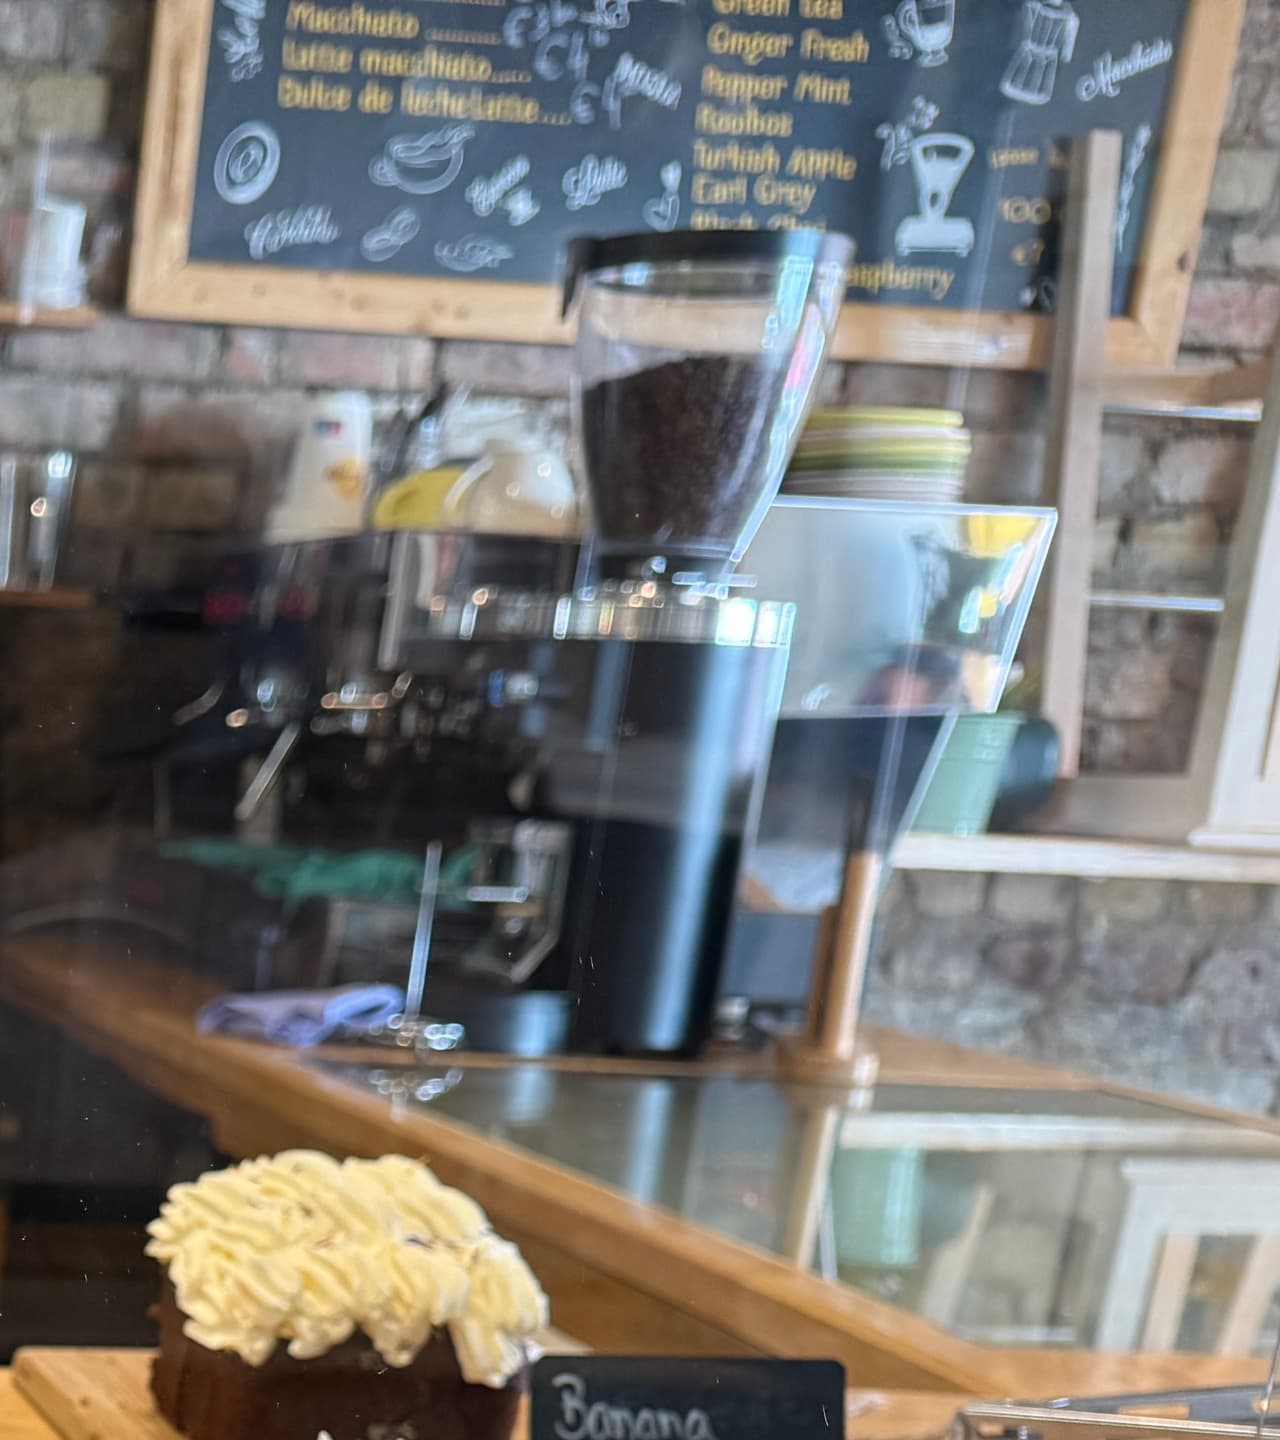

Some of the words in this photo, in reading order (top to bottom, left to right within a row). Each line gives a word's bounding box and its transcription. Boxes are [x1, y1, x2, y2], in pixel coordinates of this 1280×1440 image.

[707, 21, 794, 66] Ginger
[800, 28, 870, 63] Fresh
[701, 63, 788, 104] Pepper
[794, 71, 852, 105] Mint
[695, 101, 793, 138] Rooibos
[694, 137, 780, 174] Turkish
[786, 146, 857, 181] Apple
[691, 171, 748, 205] Earl
[753, 173, 817, 215] Grey
[846, 254, 955, 301] aspberry
